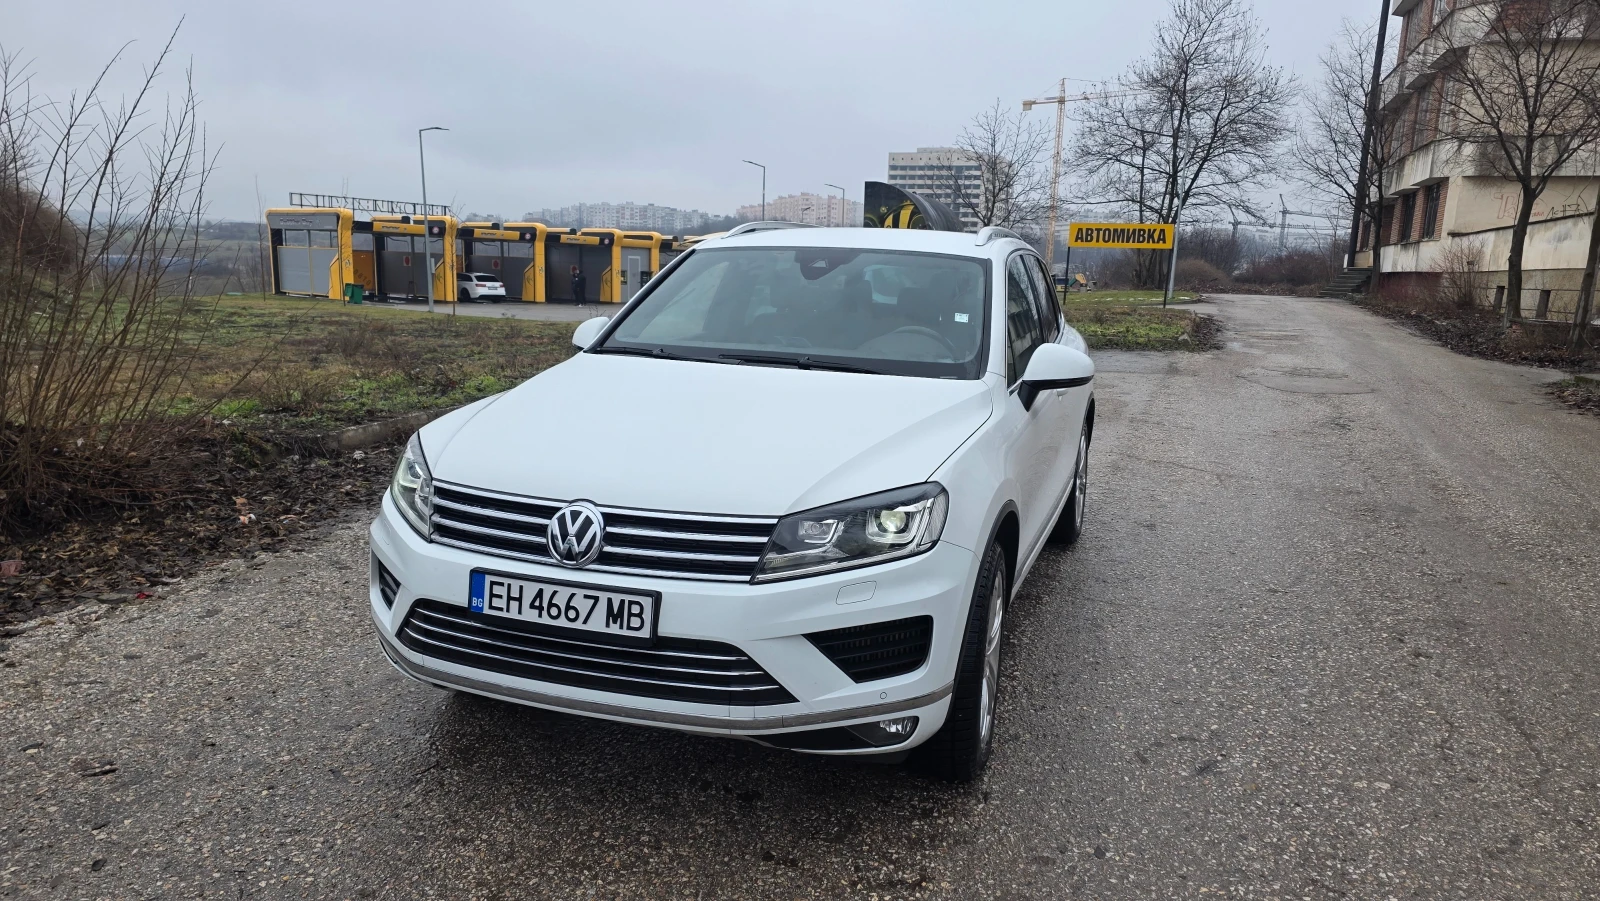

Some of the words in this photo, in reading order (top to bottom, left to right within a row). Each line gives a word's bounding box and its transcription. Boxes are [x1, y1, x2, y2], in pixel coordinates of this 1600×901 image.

[1074, 227, 1167, 244] АВТОМИВКА
[472, 597, 483, 608] BG
[488, 580, 524, 615] EH
[529, 588, 600, 626] 4667
[605, 597, 645, 632] MB
